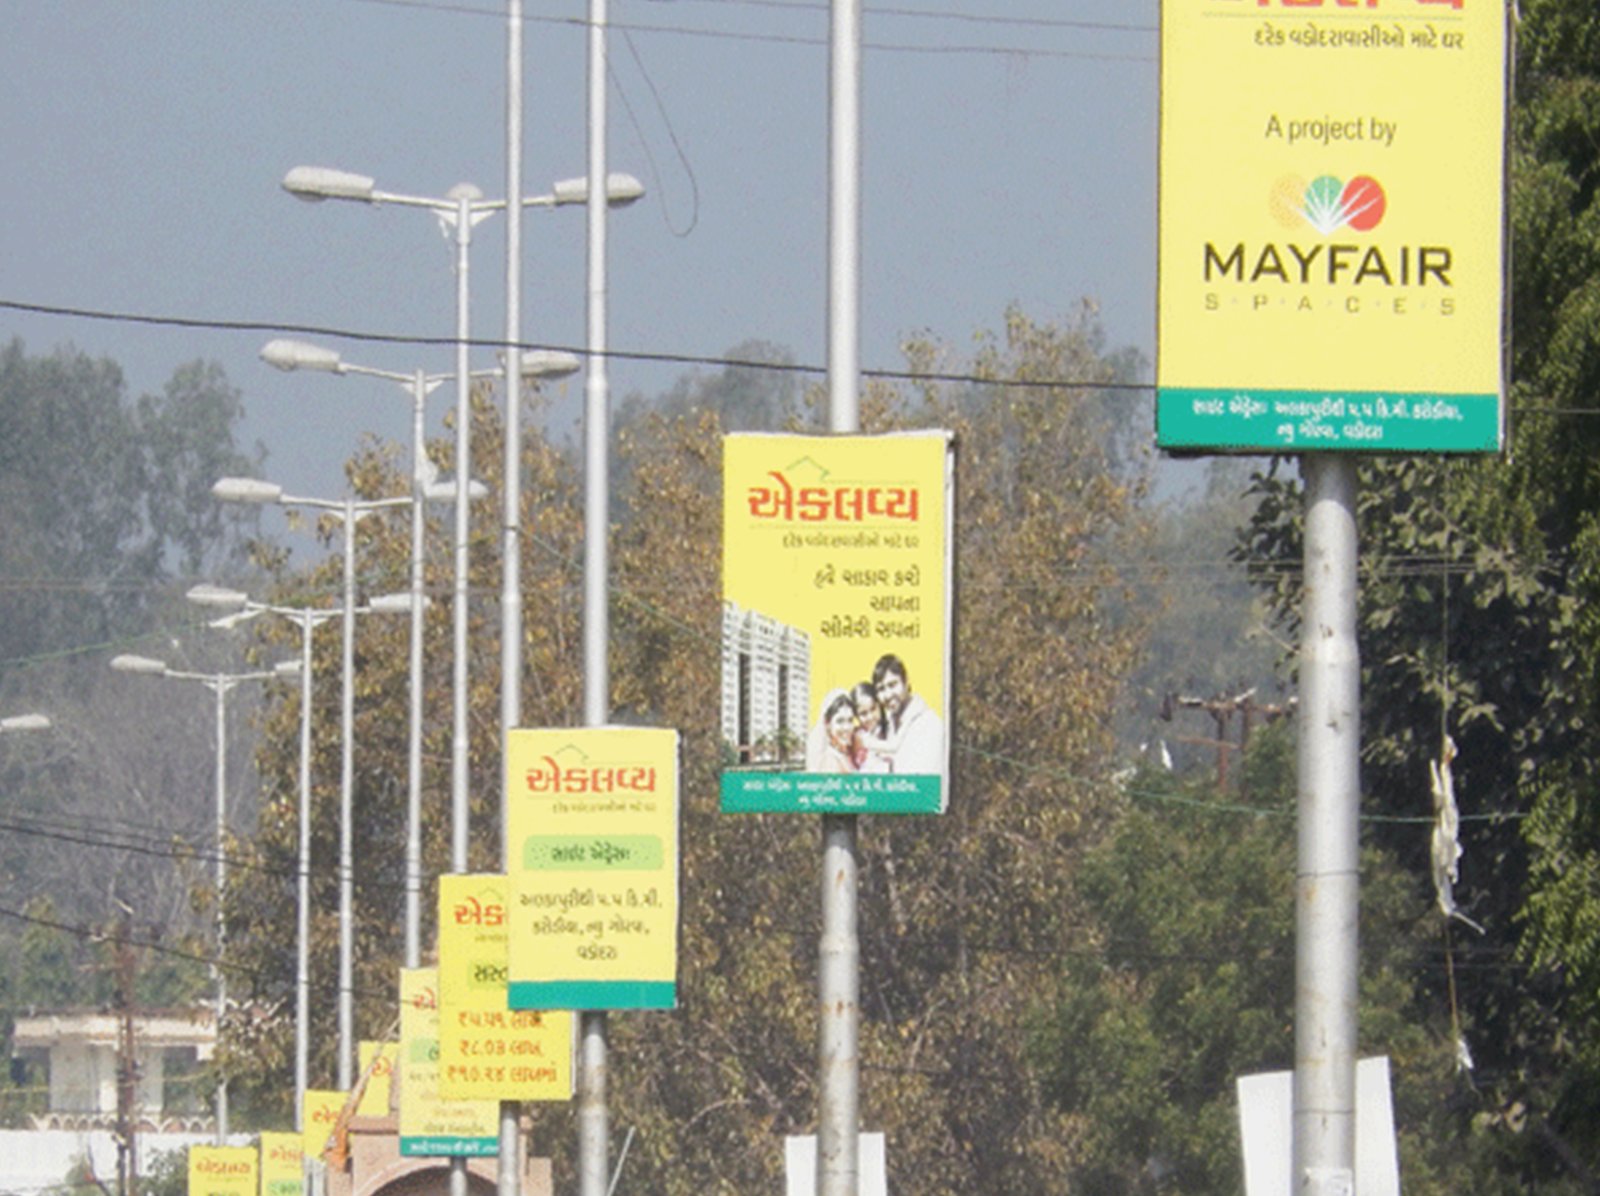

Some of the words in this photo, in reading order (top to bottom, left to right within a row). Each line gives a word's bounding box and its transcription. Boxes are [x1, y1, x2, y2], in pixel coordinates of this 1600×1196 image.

[1254, 22, 1284, 46] દરેક
[1289, 23, 1404, 48] વડોદરાવાસીઓ
[1411, 23, 1438, 49] માટે
[1442, 31, 1464, 49] ઘર
[1266, 115, 1282, 138] A
[1288, 118, 1364, 145] project
[1370, 117, 1396, 146] by
[1204, 243, 1453, 286] MAYFAIR
[748, 471, 919, 521] એકલવ્ય
[894, 564, 920, 587] કરો
[525, 755, 657, 793] એકલવ્ય
